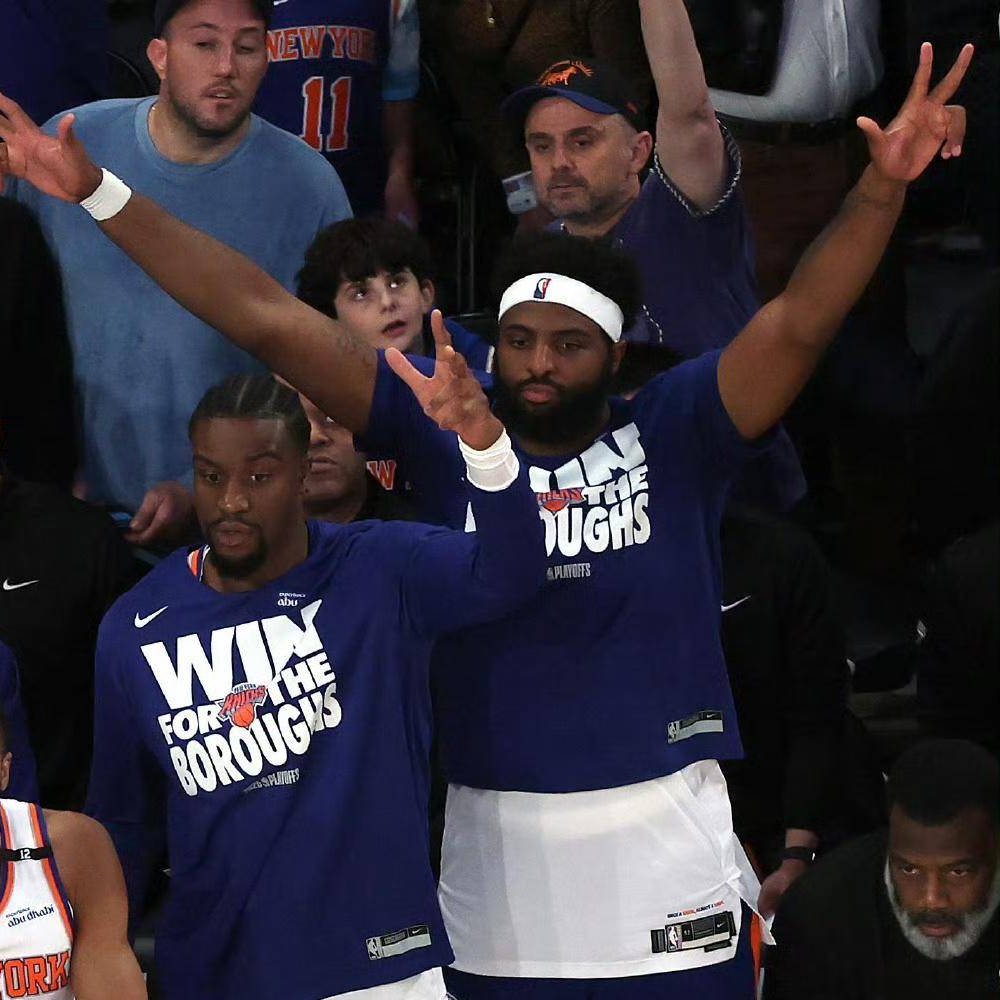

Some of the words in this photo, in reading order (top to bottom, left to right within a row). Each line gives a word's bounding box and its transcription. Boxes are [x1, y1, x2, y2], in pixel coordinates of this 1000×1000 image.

[266, 25, 326, 62] NEW
[302, 76, 352, 152] 11
[584, 464, 649, 505] THE
[554, 563, 591, 579] PLAYOFFS
[277, 597, 298, 606] abu
[141, 599, 324, 709] WIN
[157, 705, 223, 745] FOR
[267, 651, 336, 706] THE
[170, 682, 342, 797] BOROUGHS
[20, 848, 32, 860] 12
[7, 915, 27, 928] abu
[26, 903, 55, 921] dhabi
